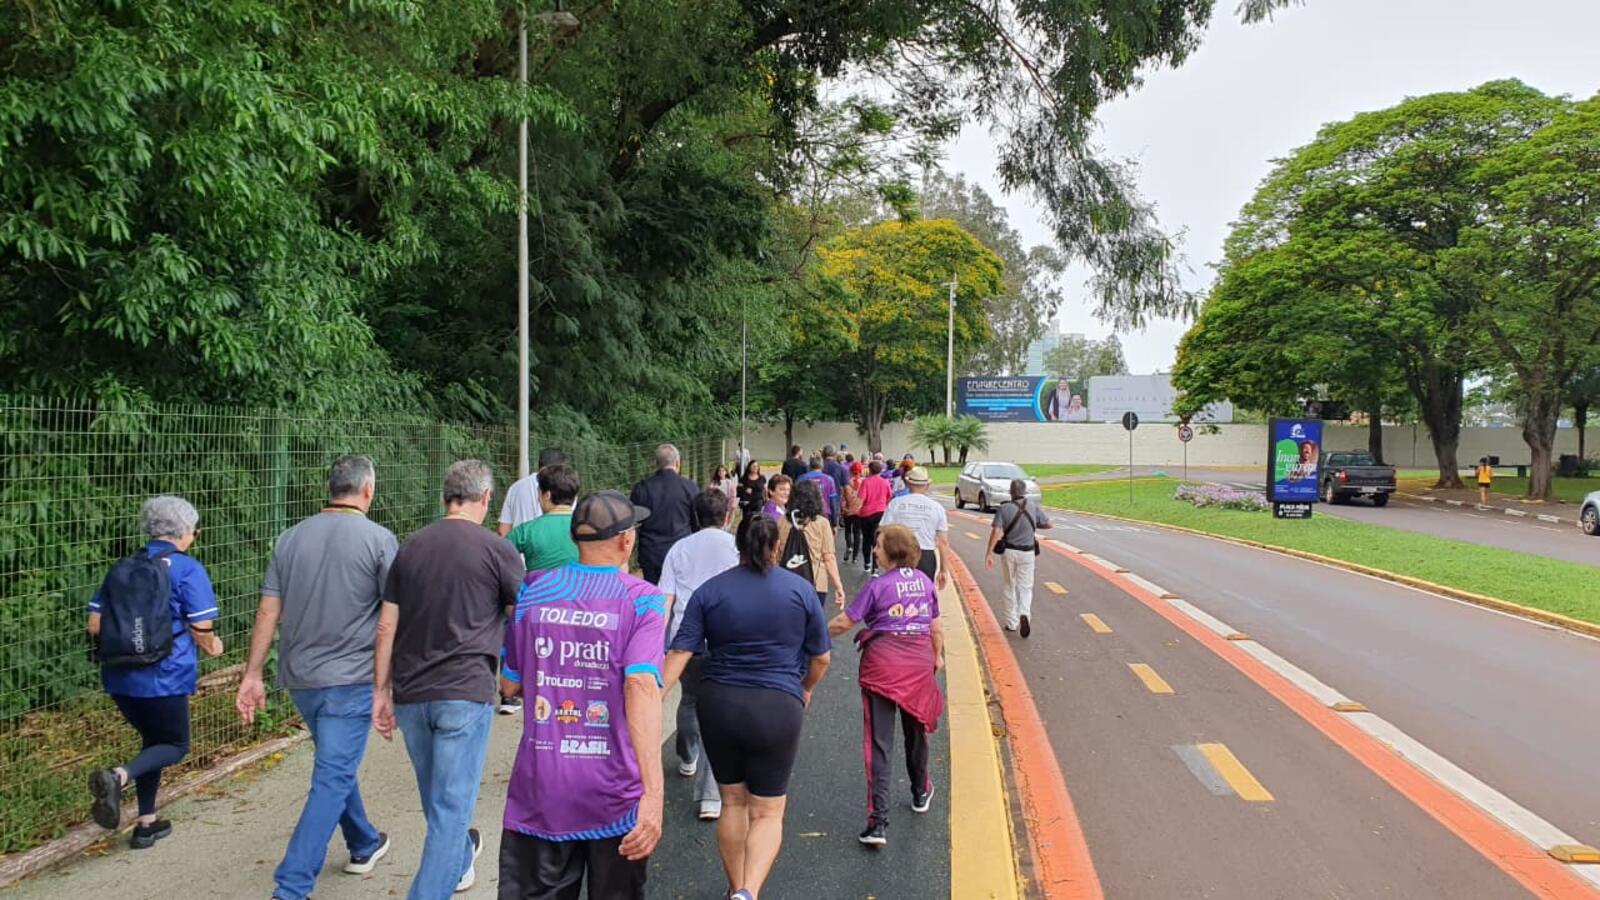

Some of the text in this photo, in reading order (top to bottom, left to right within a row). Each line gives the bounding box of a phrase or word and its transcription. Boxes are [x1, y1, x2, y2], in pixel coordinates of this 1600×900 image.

[896, 578, 925, 600] prati
[539, 607, 608, 628] TOLEDO
[131, 616, 144, 654] adidas
[560, 641, 610, 666] prati
[544, 675, 583, 688] TOLEDO
[560, 739, 611, 755] BRASIL
